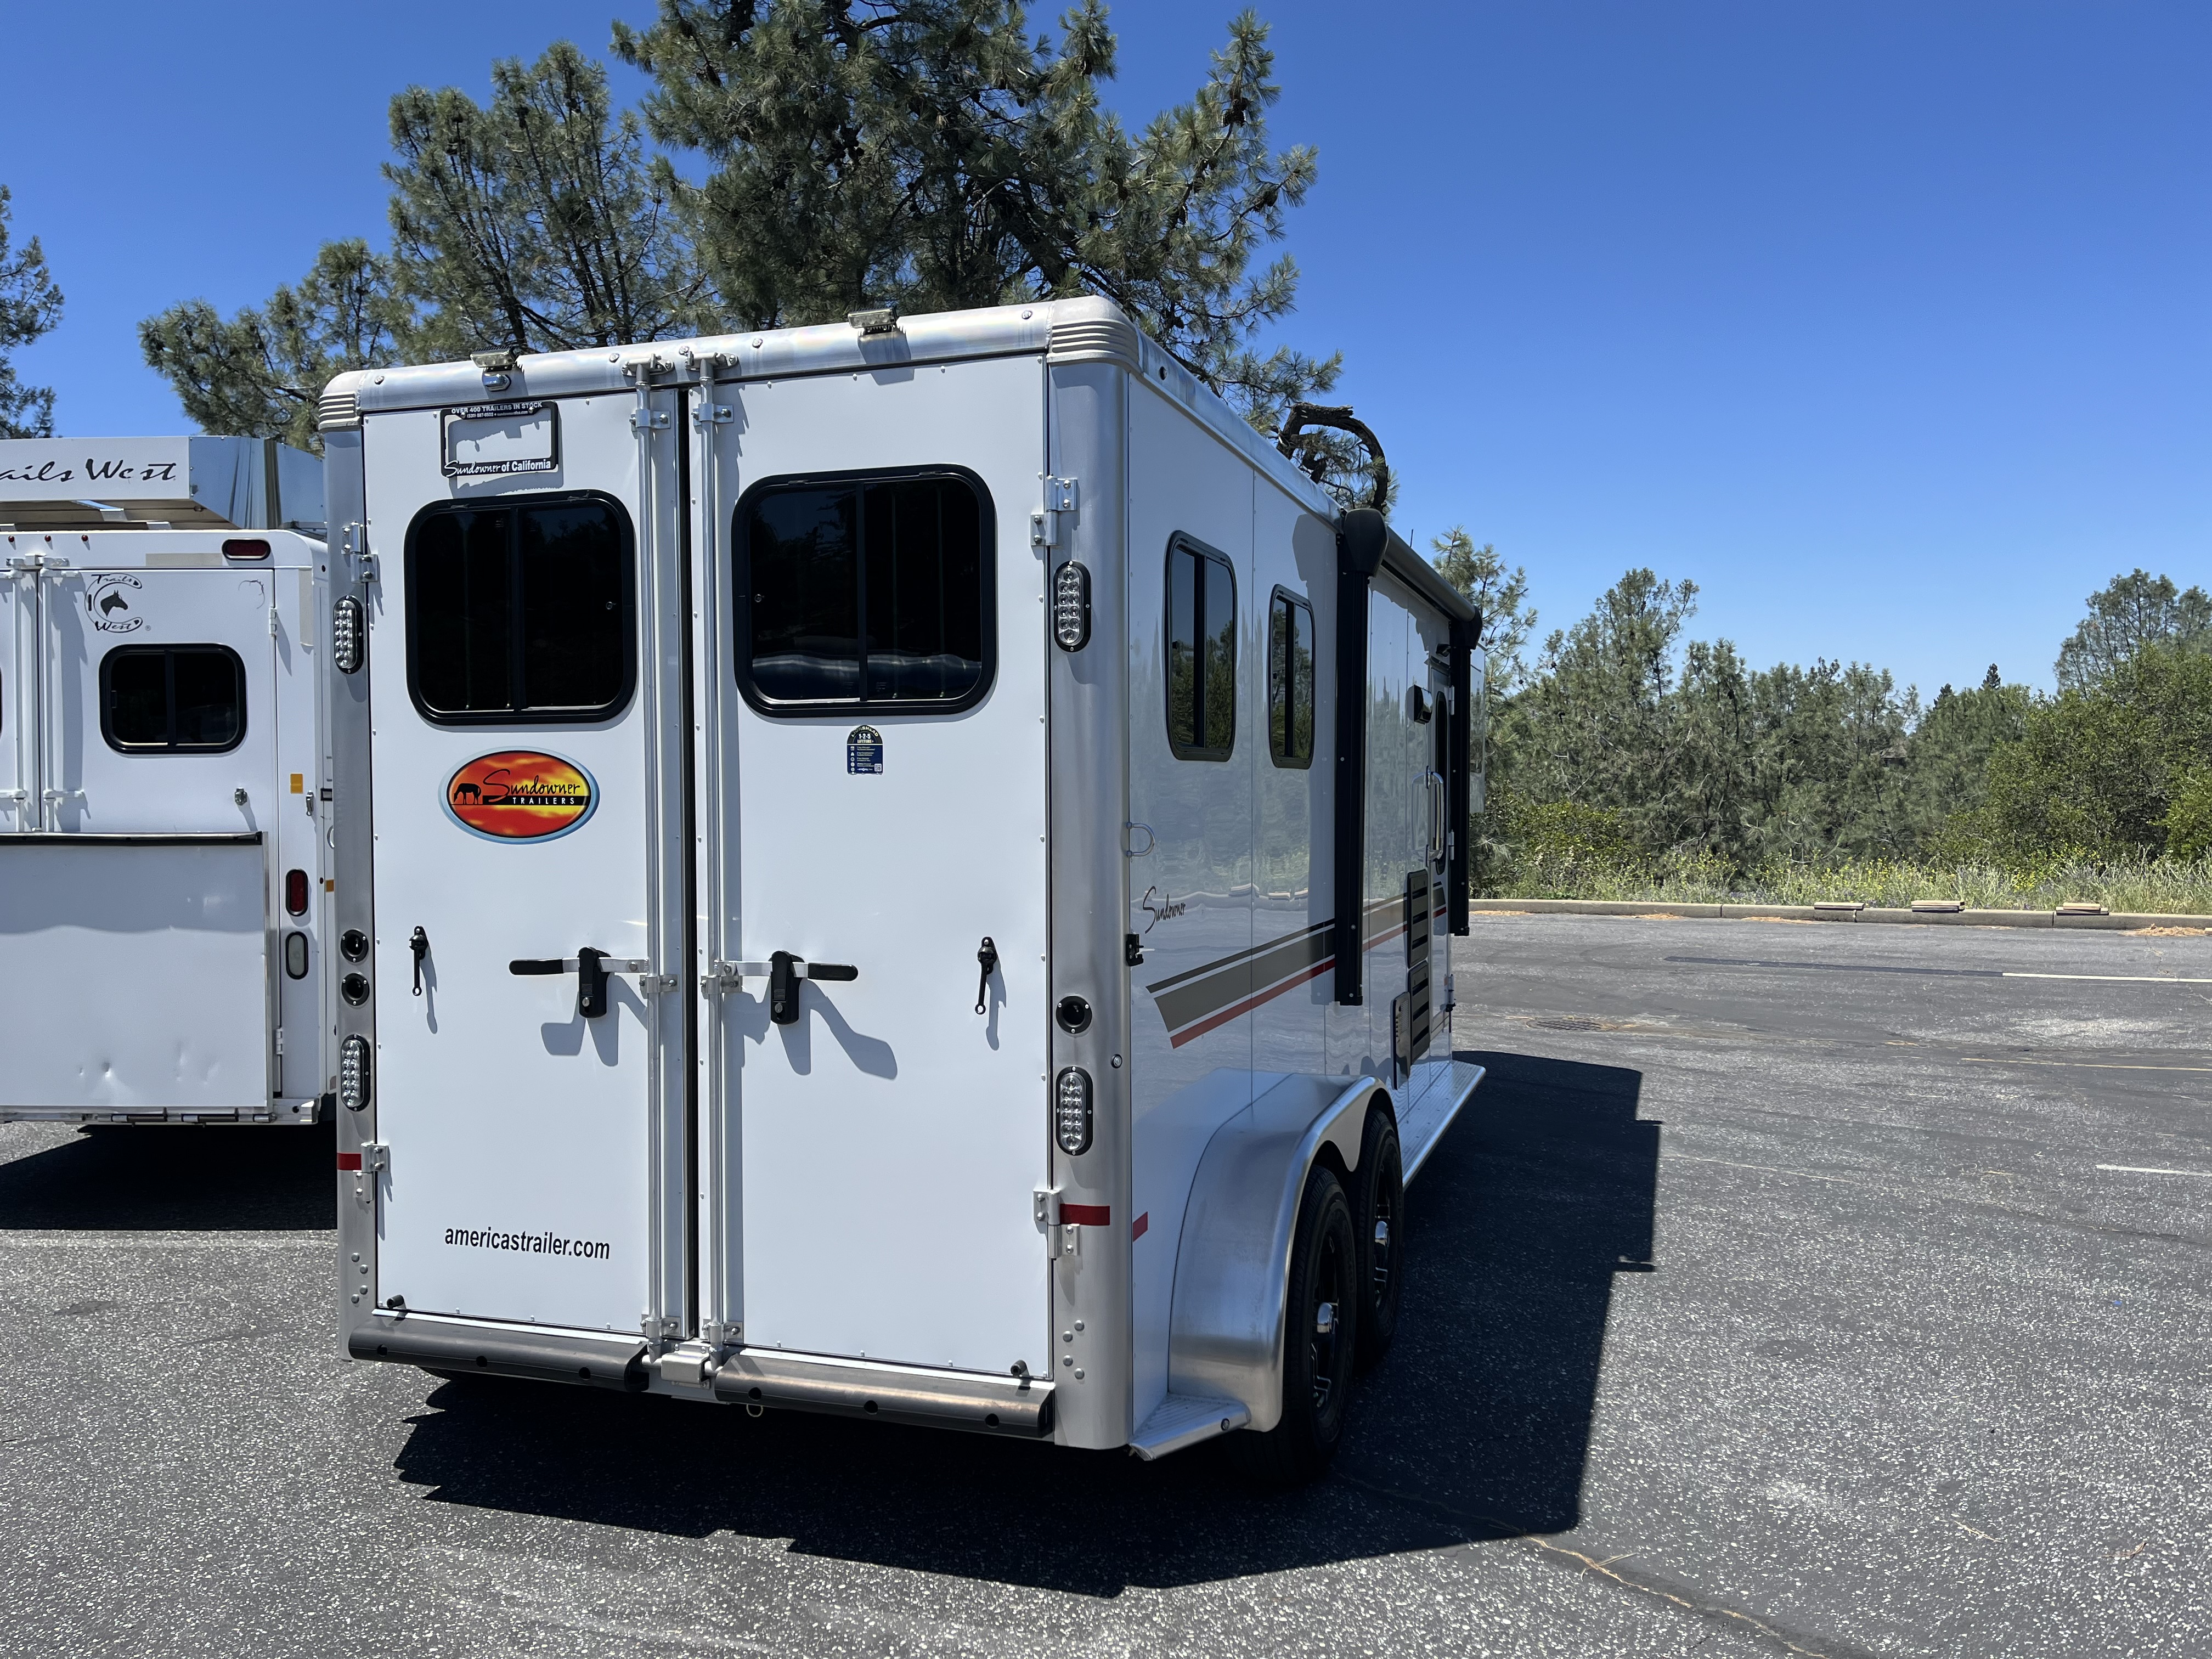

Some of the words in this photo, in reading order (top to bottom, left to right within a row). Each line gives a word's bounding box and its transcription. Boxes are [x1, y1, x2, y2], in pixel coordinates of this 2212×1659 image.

[85, 458, 177, 481] West
[444, 460, 501, 477] Sundowner
[501, 461, 510, 472] of
[511, 459, 551, 471] California
[91, 574, 132, 584] Trails
[94, 620, 132, 631] West
[483, 769, 580, 802] Sundowner
[1142, 885, 1186, 934] Sundowner
[444, 1226, 610, 1260] americastrailer.com
